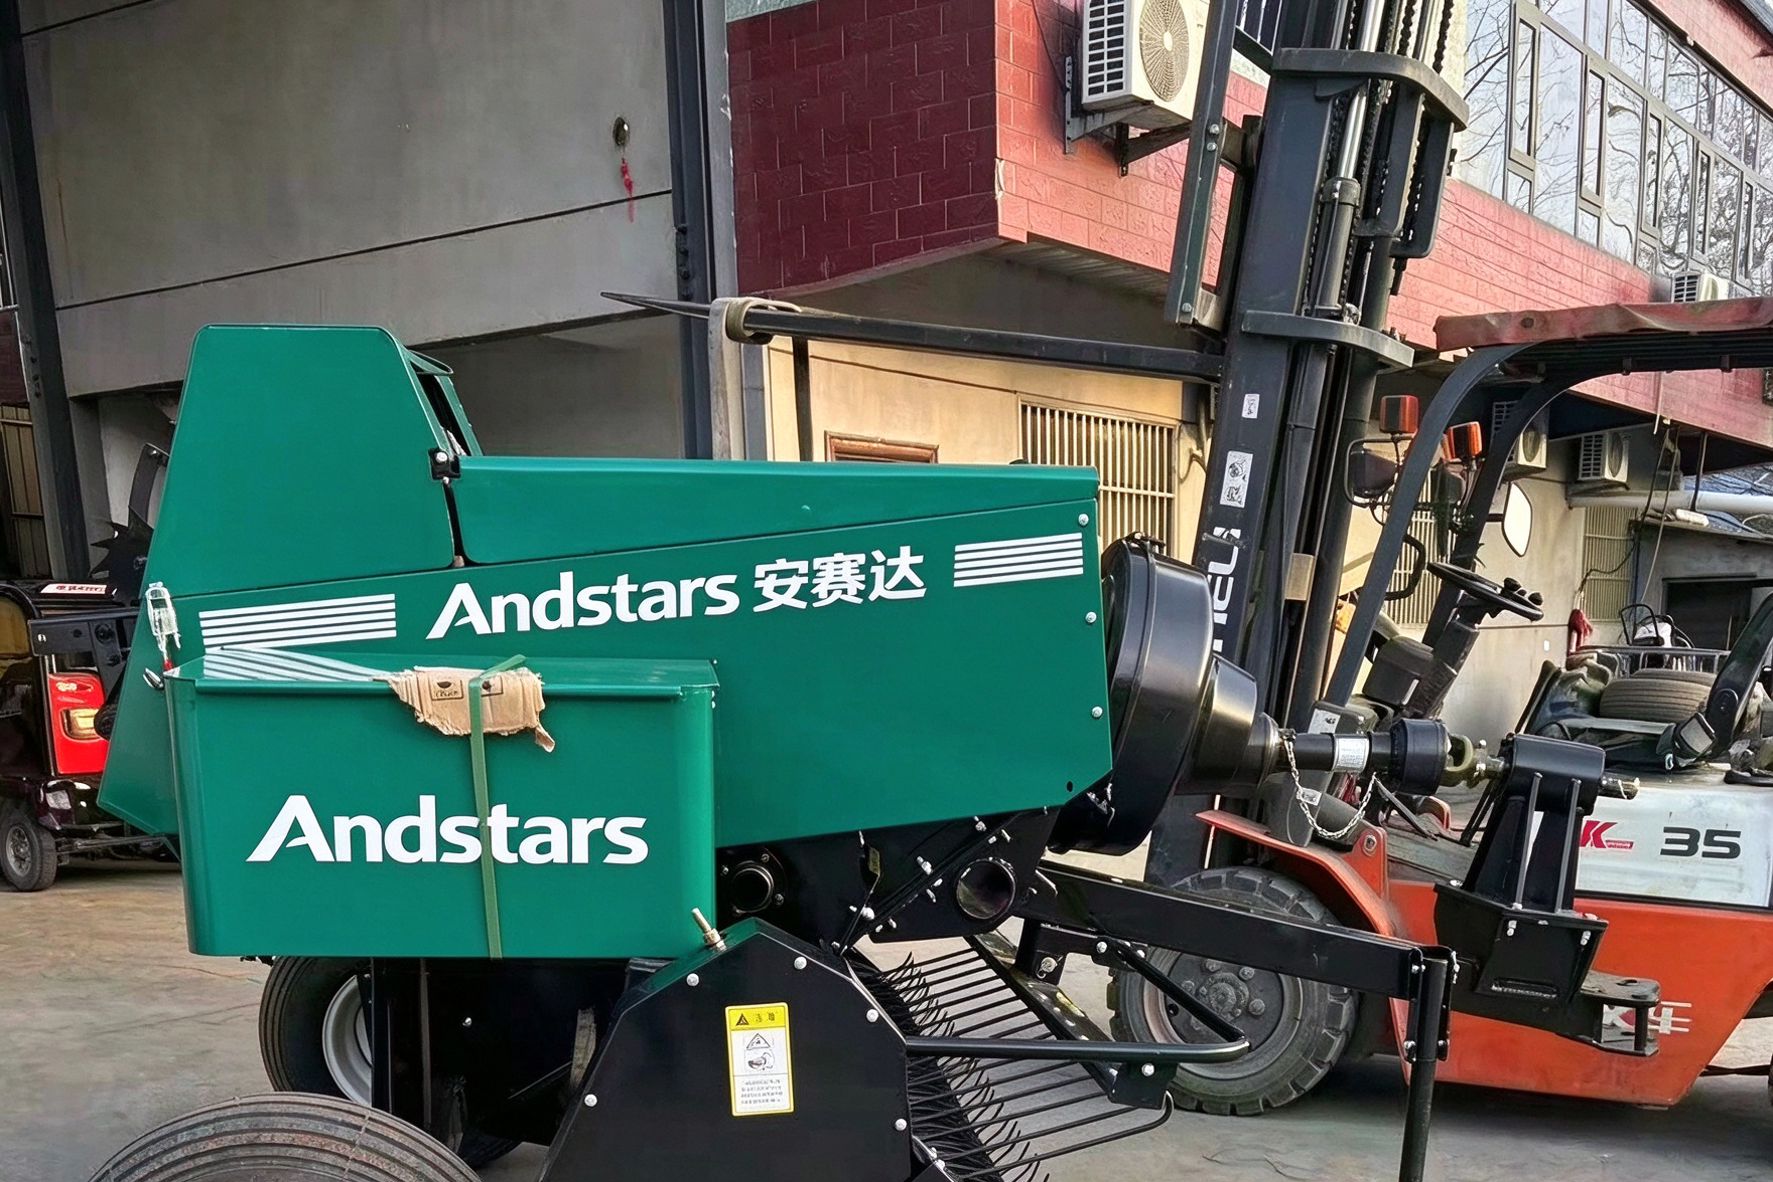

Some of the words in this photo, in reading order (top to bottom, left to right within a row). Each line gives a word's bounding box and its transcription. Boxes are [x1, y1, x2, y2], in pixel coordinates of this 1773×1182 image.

[426, 571, 739, 639] Andstars
[754, 546, 926, 612] 安赛达
[247, 795, 648, 864] Andstars
[1659, 826, 1742, 860] 35
